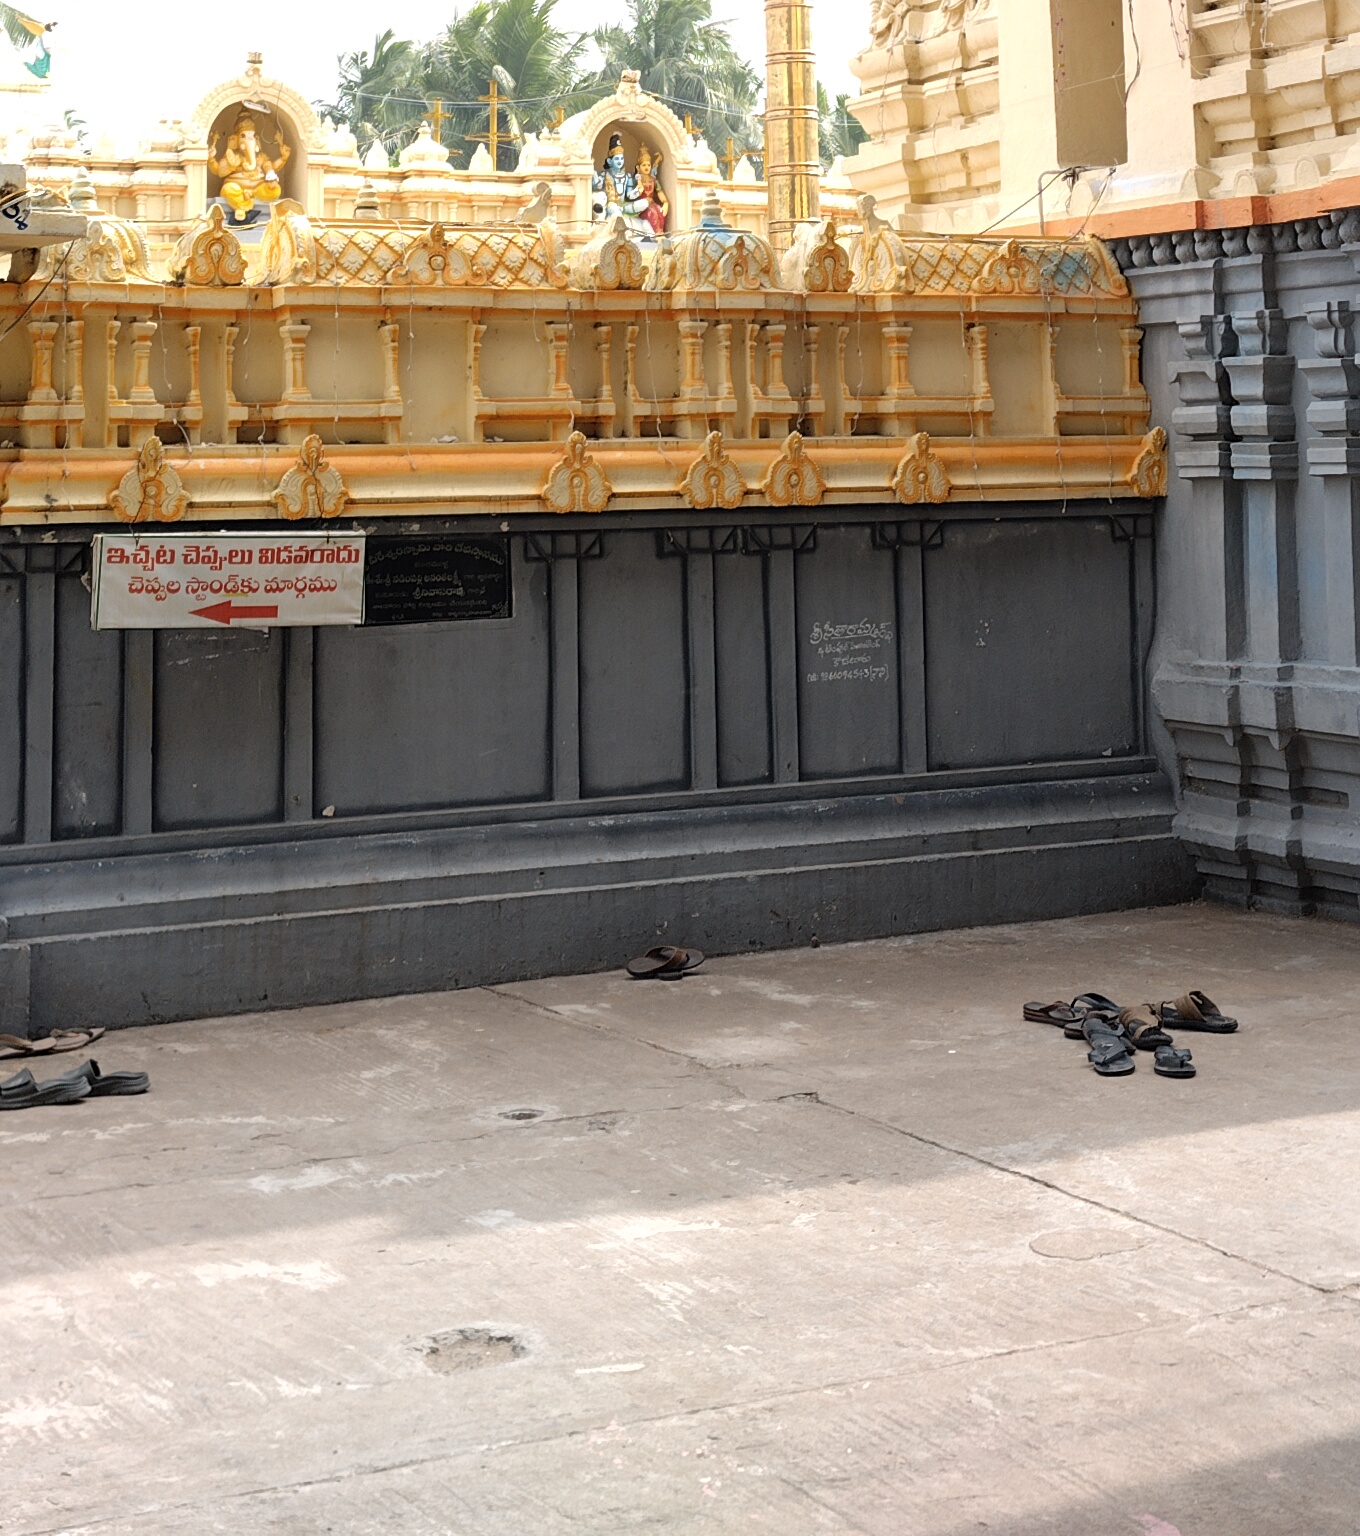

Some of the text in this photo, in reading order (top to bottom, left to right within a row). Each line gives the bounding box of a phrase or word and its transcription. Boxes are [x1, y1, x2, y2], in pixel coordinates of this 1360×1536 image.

[107, 545, 360, 571] ఇచ్చట చెప్పులు విడవరాదు
[128, 576, 181, 601] చెప్పుల
[264, 576, 338, 599] మార్గము
